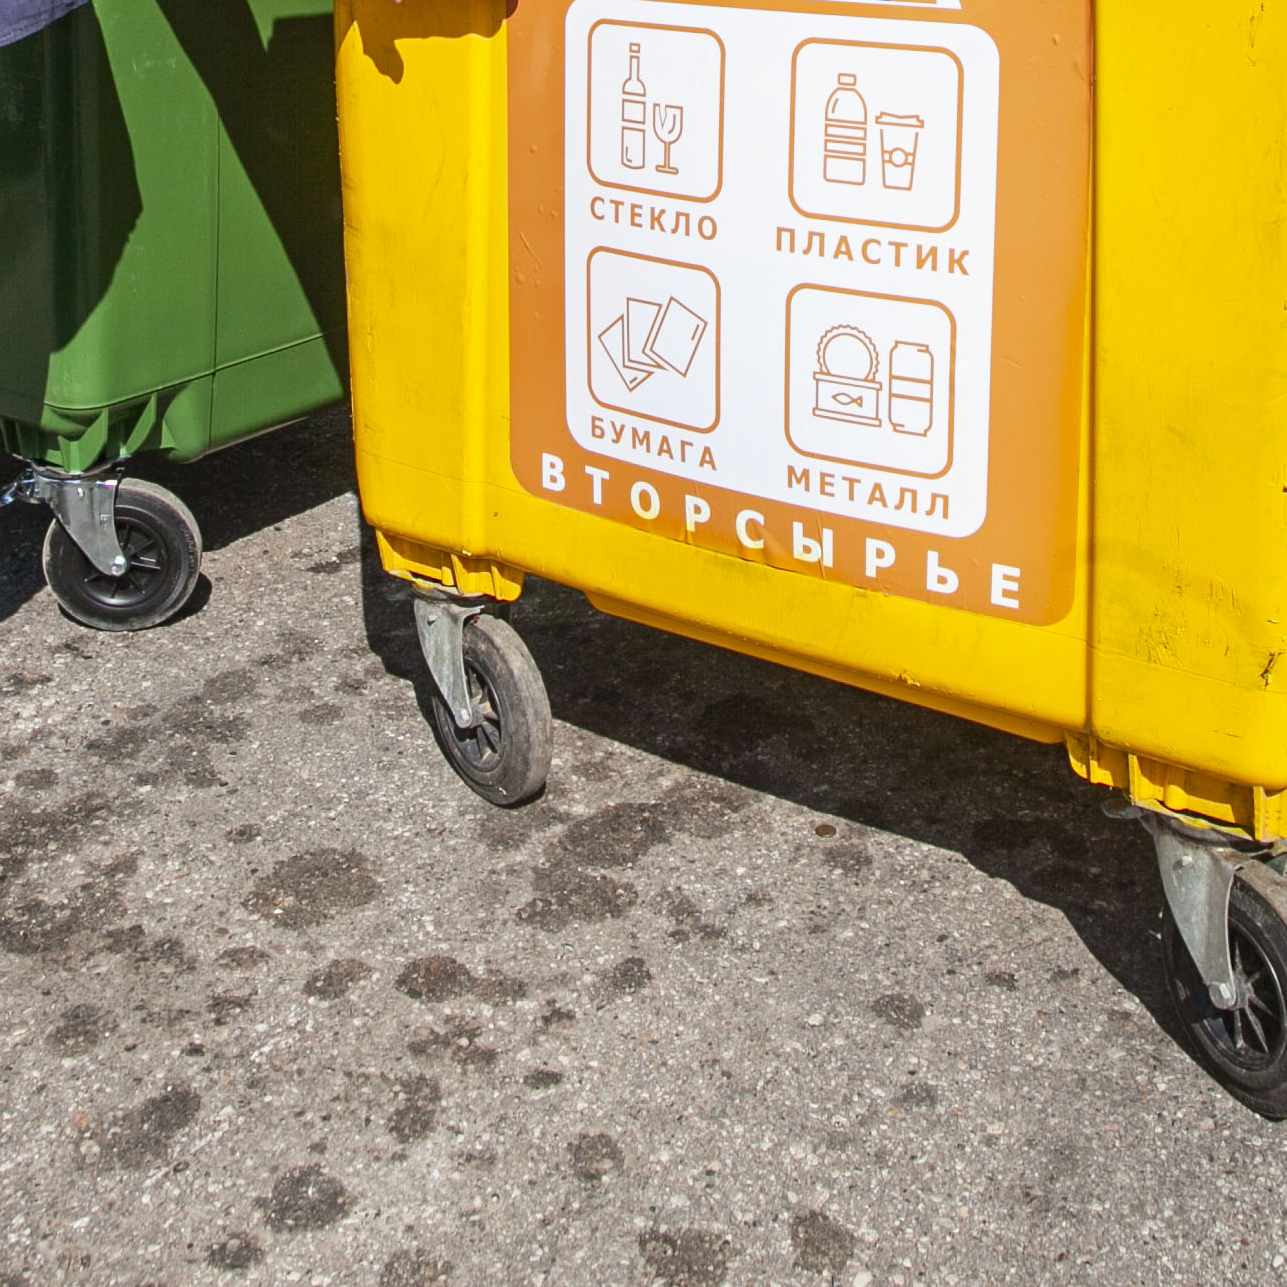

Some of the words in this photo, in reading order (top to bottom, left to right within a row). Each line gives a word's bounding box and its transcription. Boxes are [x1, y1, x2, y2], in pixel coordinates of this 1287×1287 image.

[589, 196, 718, 242] СТЕКЛО
[775, 226, 970, 277] ПЛАСТИК
[590, 415, 717, 471] БУМАГА
[786, 465, 950, 520] МЕТАЛЛ
[540, 451, 1022, 611] ВТОРСЫРЬЕ
